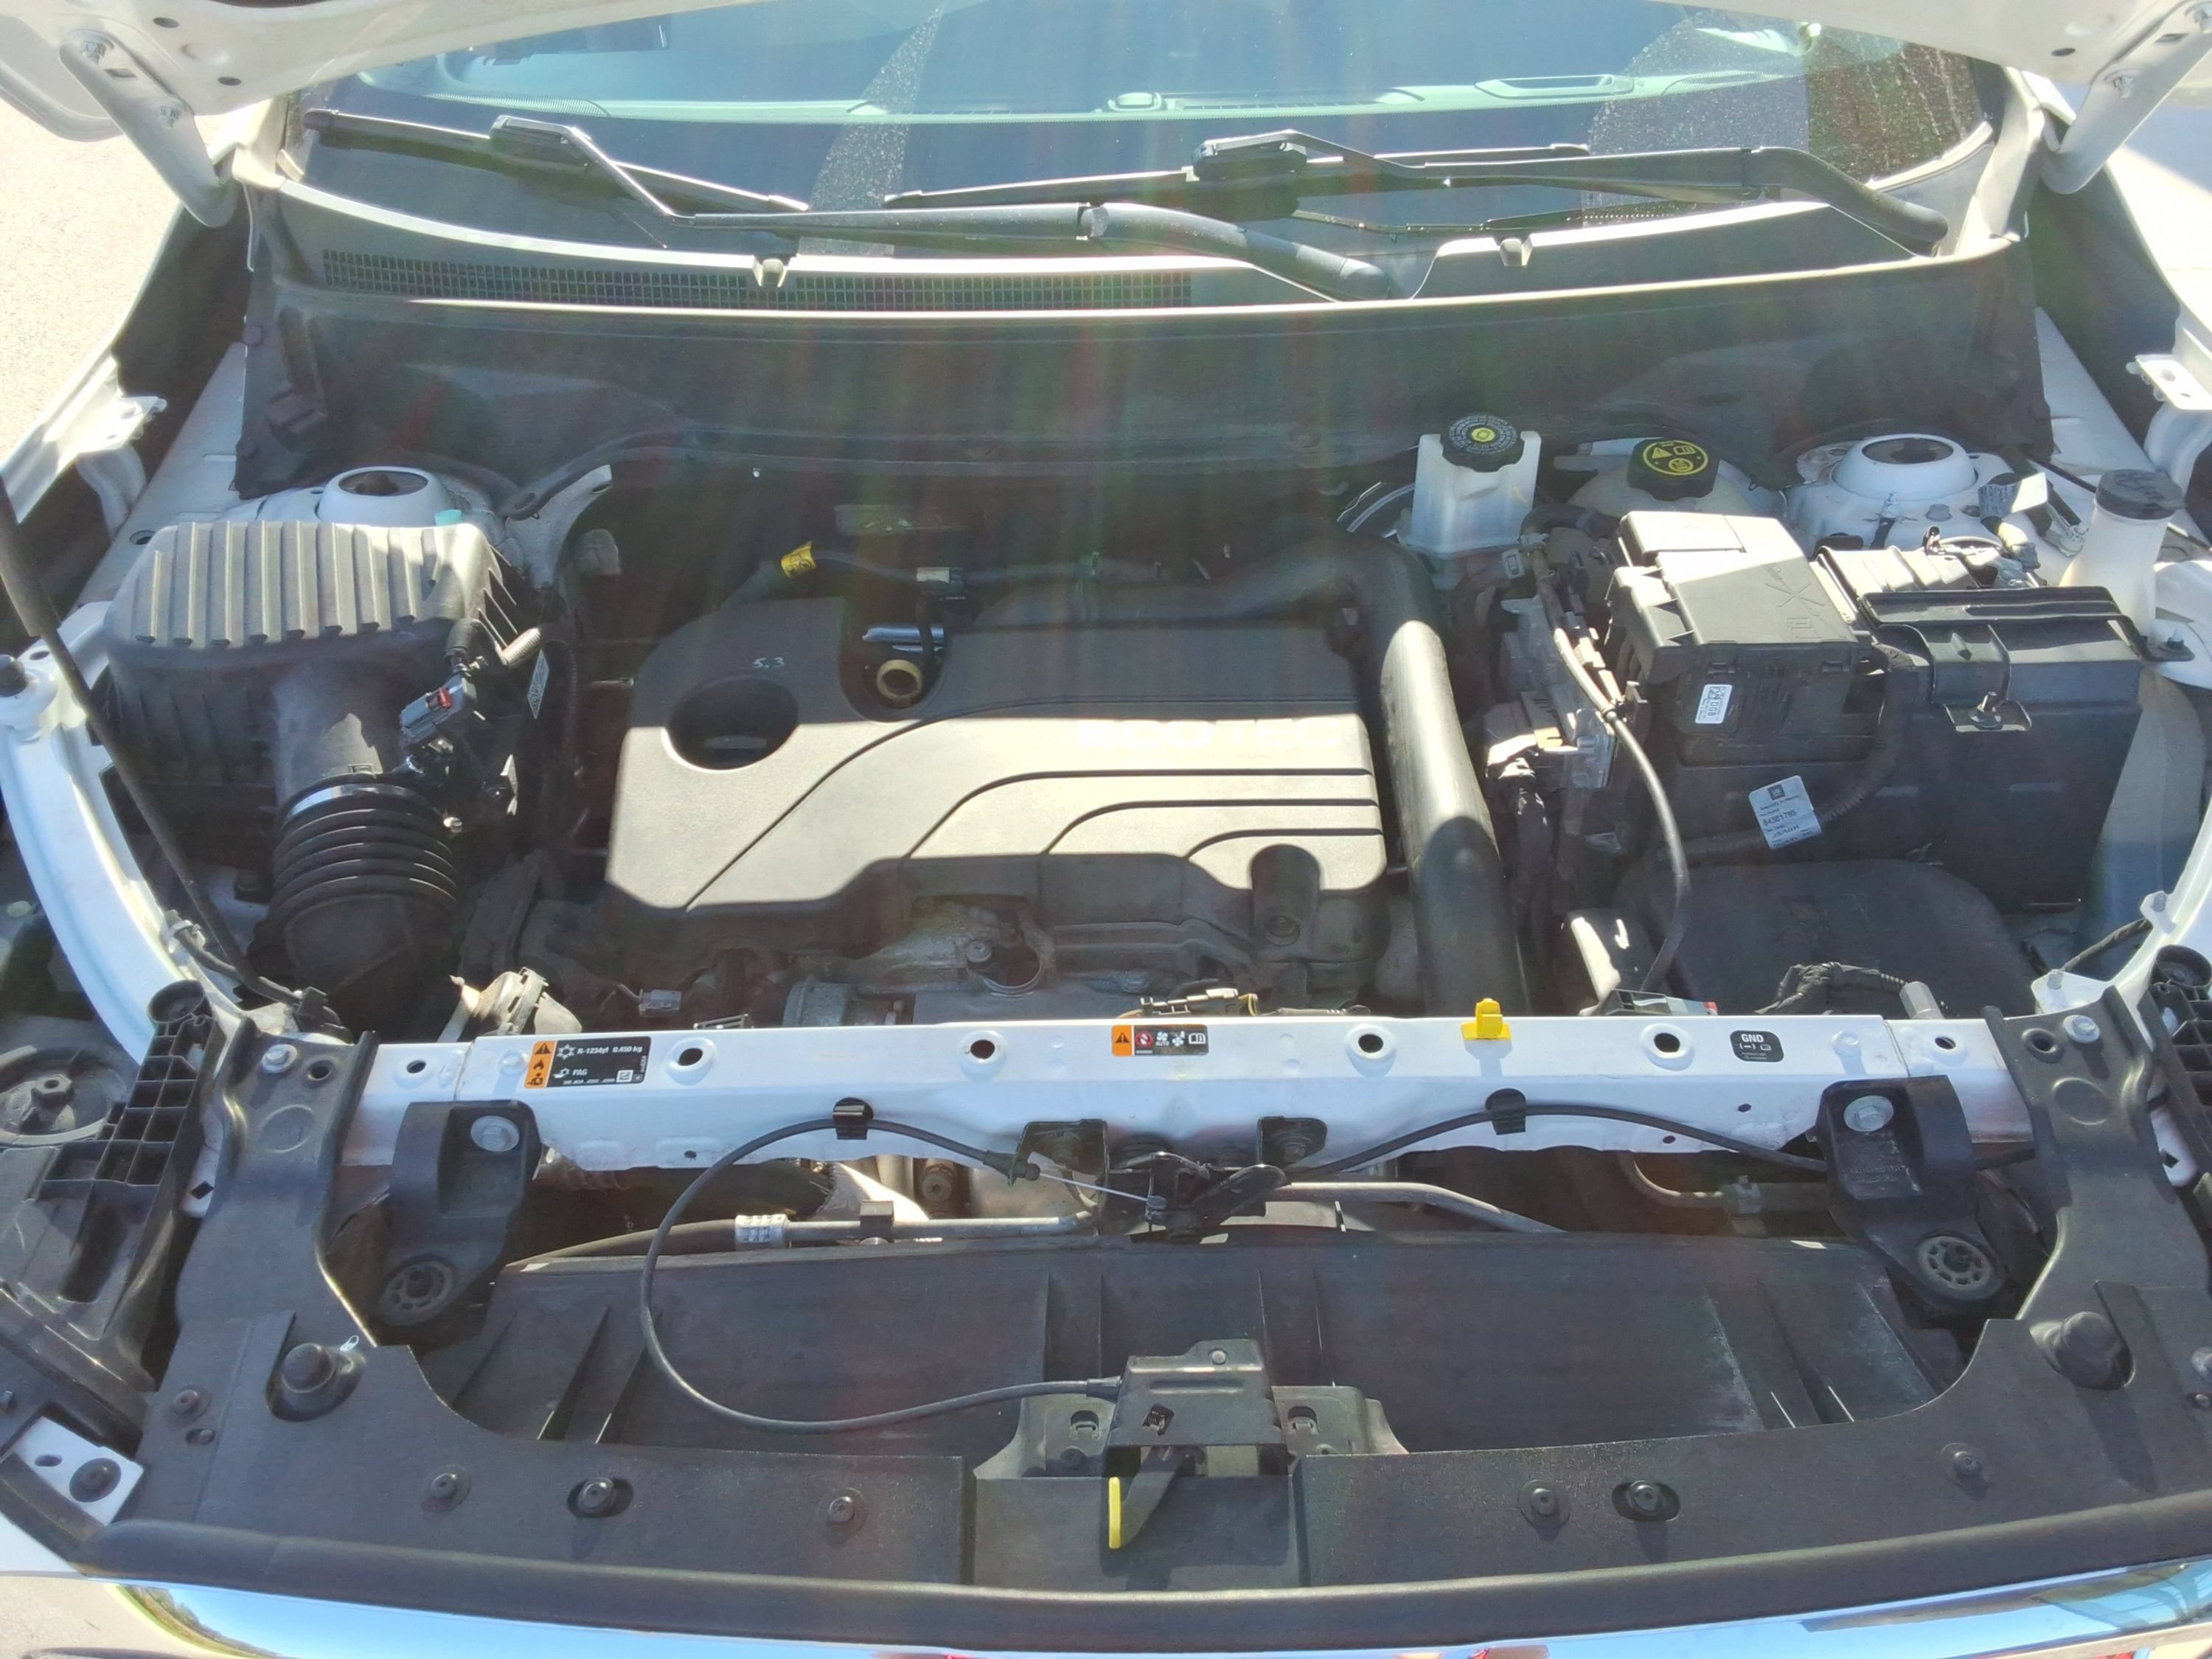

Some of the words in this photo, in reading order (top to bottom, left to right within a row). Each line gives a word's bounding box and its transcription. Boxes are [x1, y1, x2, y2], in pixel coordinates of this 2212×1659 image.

[1708, 701, 1719, 716] DGB
[1741, 1034, 1764, 1043] GND
[633, 1046, 644, 1054] kg
[572, 1068, 588, 1077] PAG
